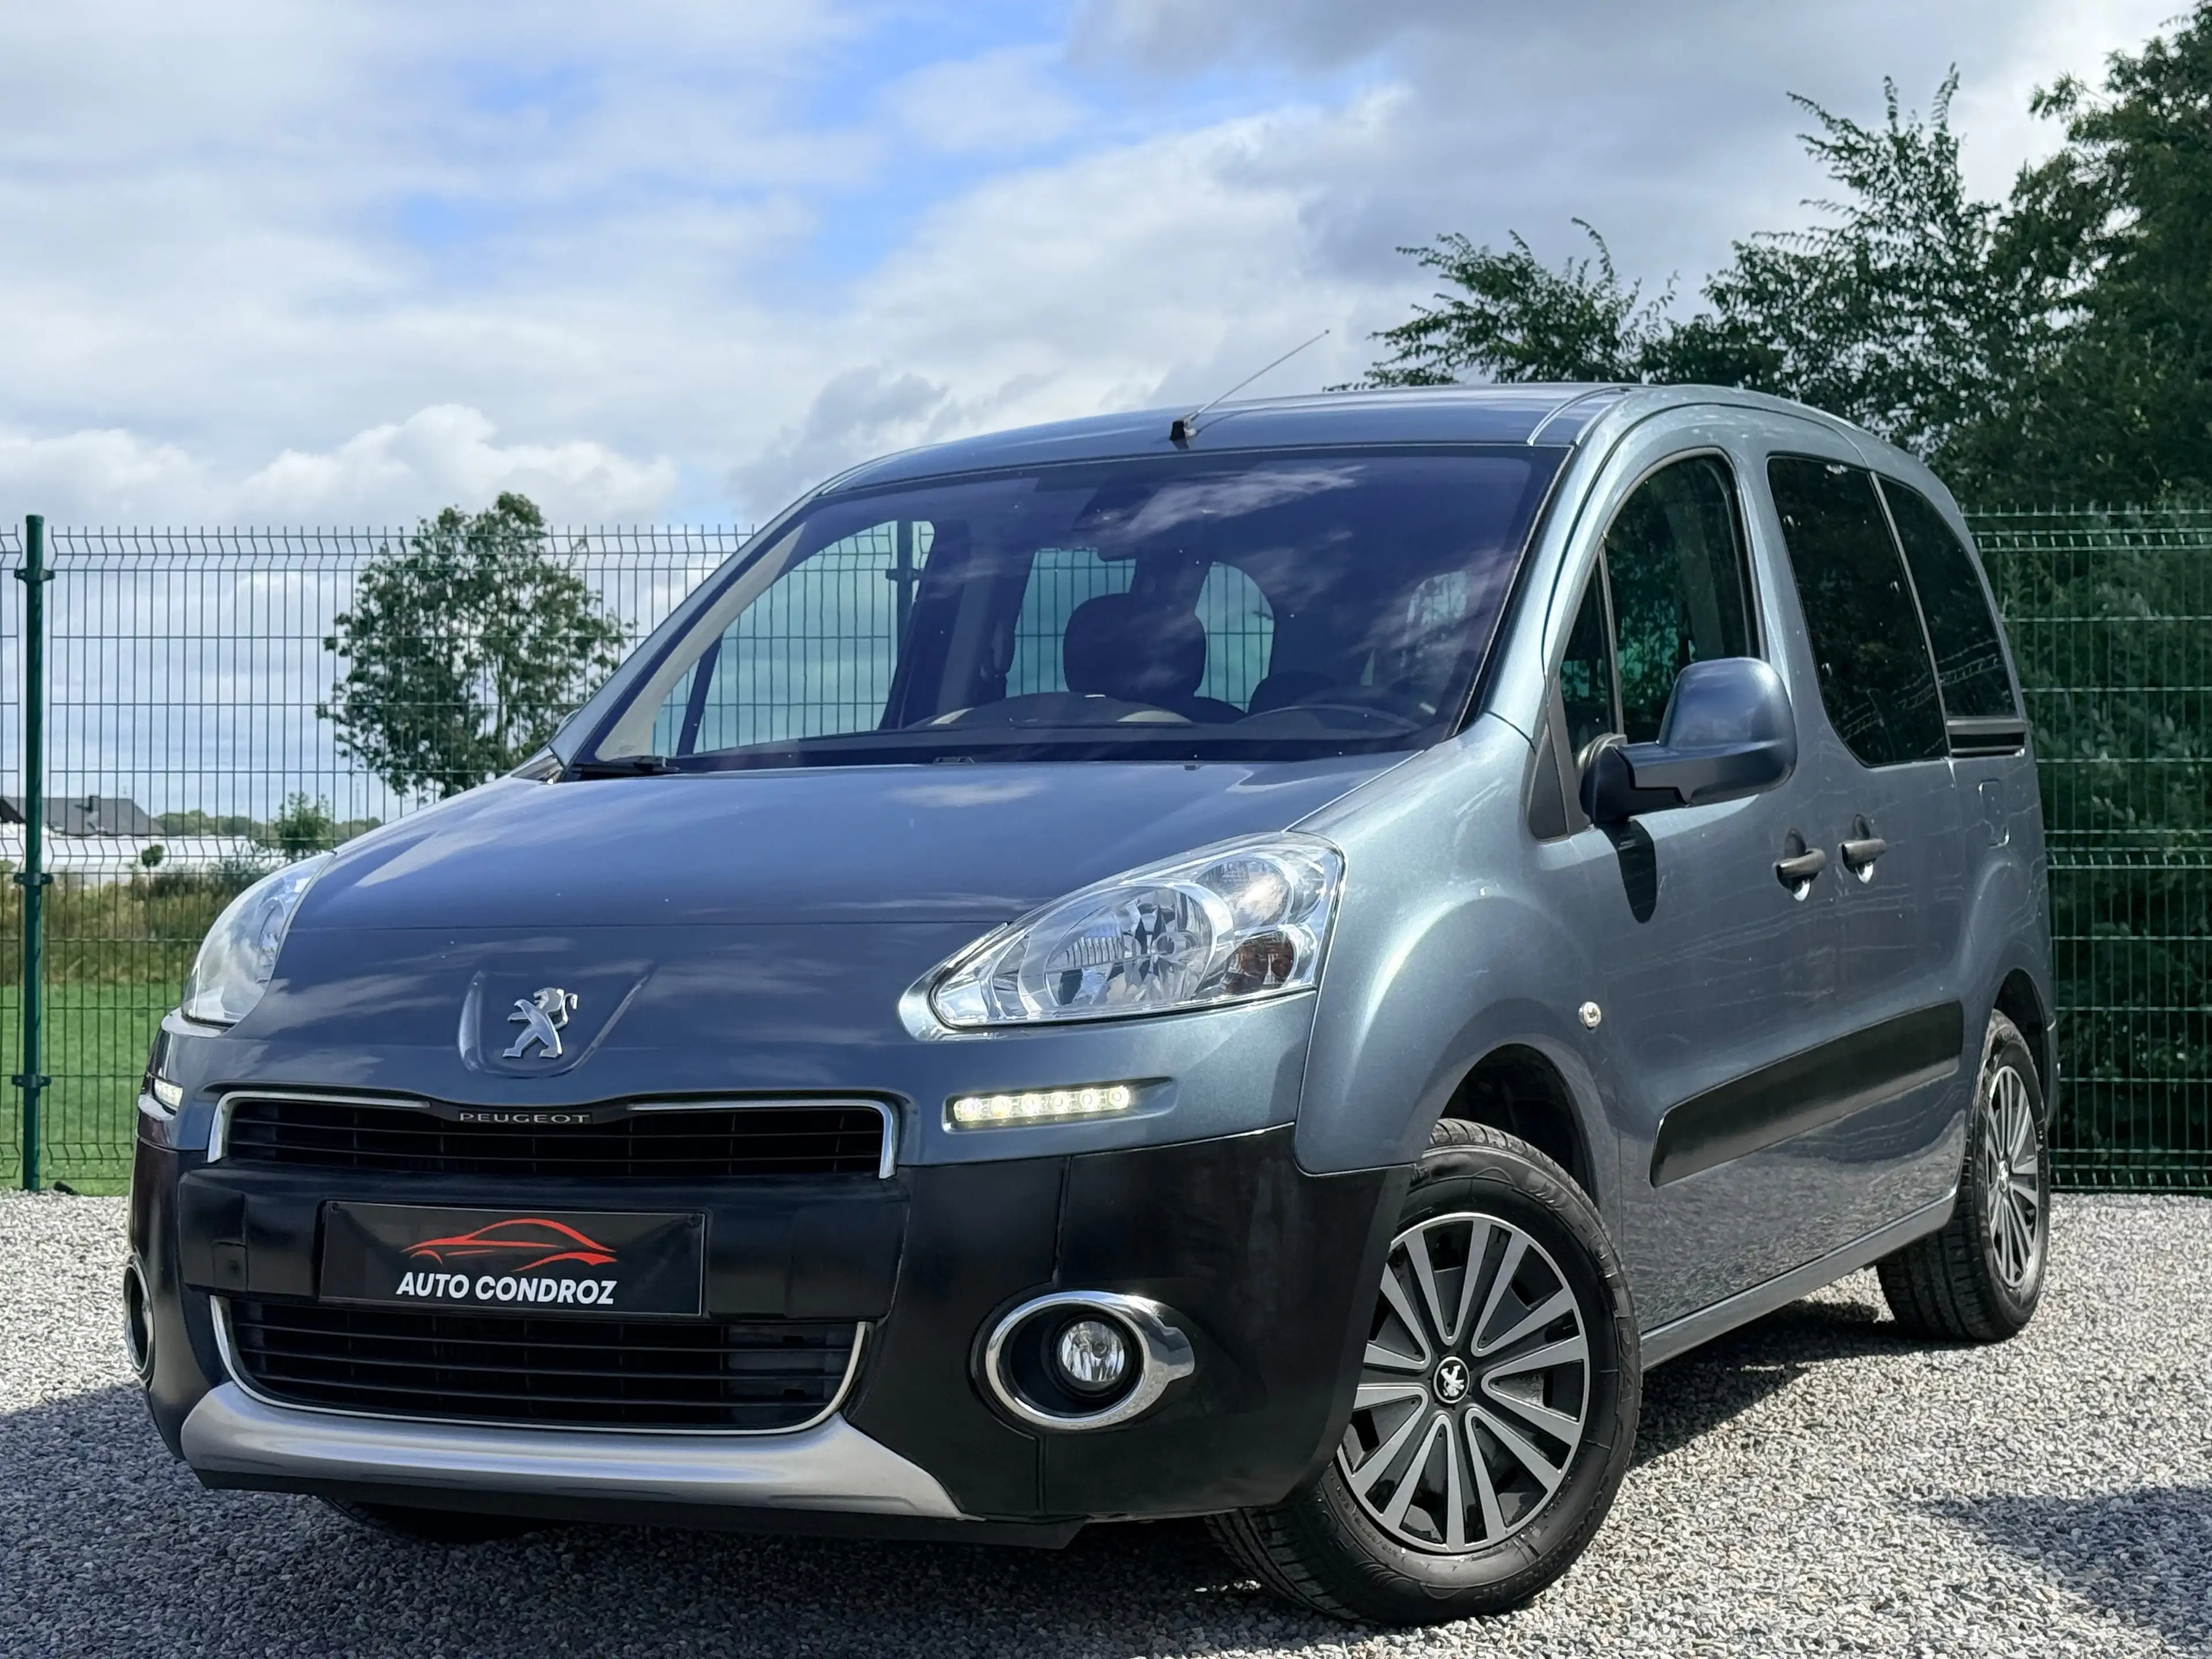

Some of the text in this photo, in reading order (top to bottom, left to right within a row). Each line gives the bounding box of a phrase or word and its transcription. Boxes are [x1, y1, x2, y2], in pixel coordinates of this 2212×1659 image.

[459, 1112, 590, 1123] PEUGEOT
[396, 1271, 618, 1305] AUTO CONDROZ
